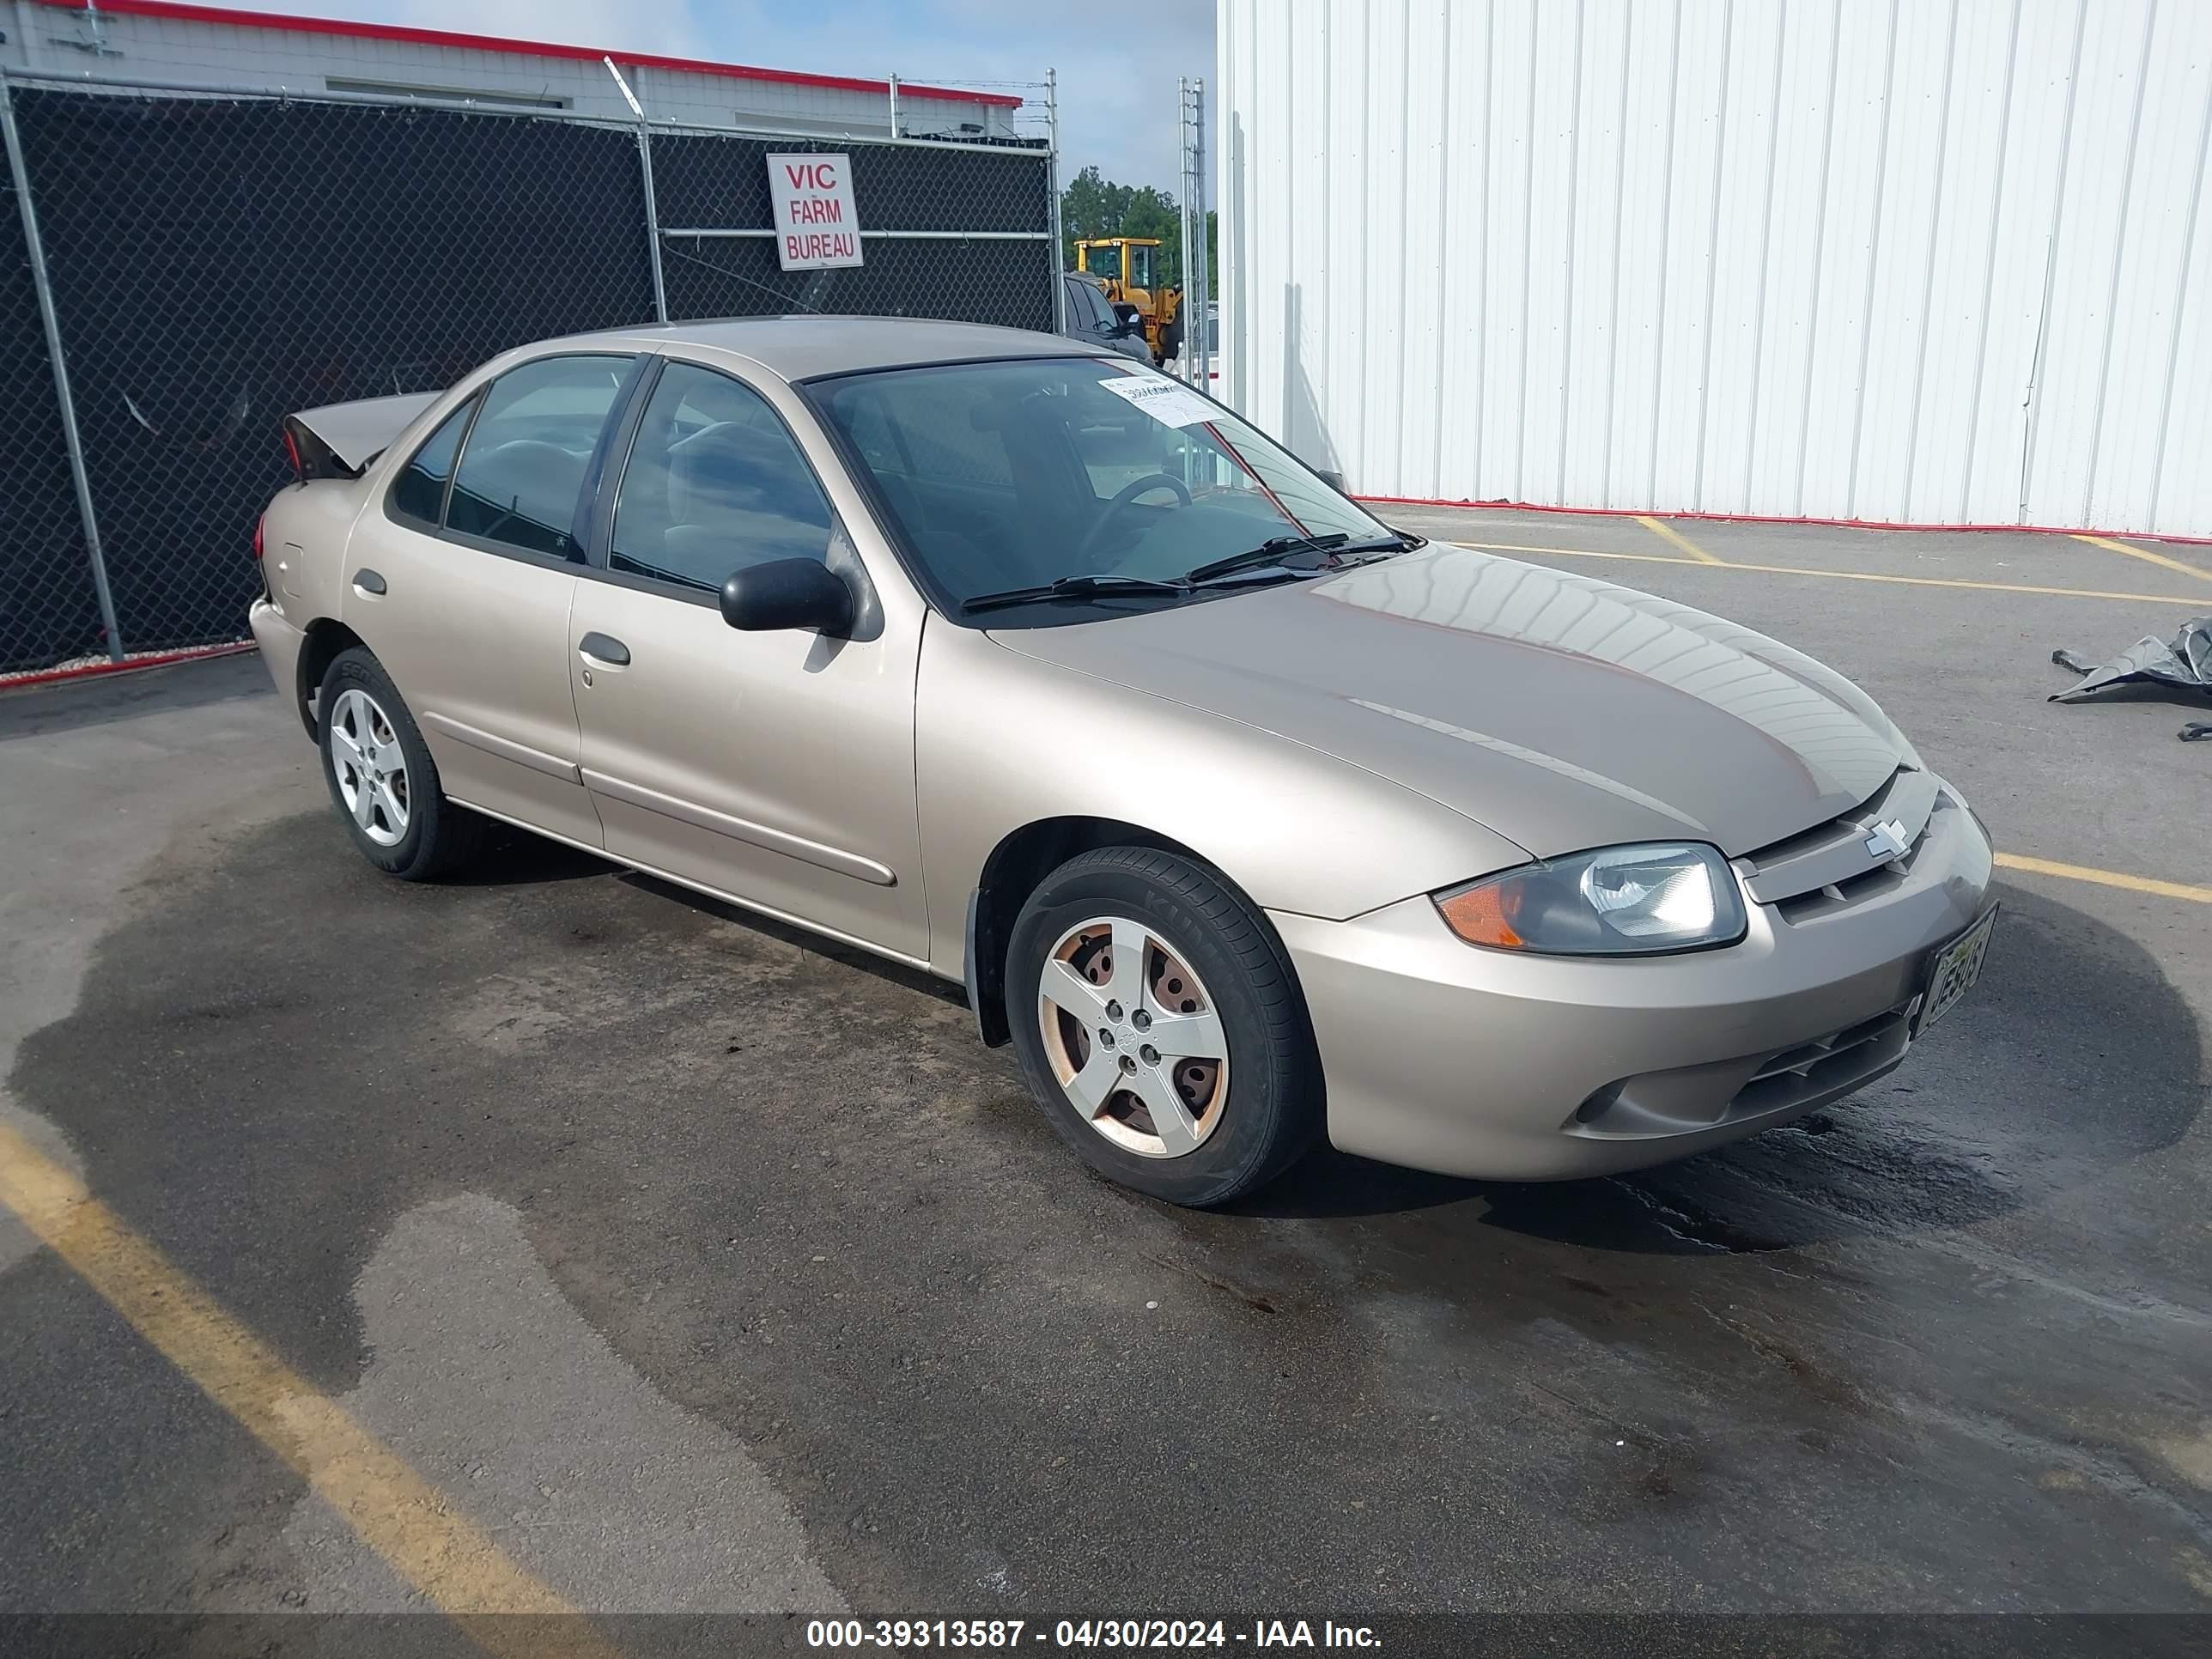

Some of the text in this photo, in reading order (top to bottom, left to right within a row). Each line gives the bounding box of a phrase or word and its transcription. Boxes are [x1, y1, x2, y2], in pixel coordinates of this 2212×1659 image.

[785, 163, 837, 190] VIC
[790, 198, 842, 224] FARM
[786, 233, 854, 260] BUREAU
